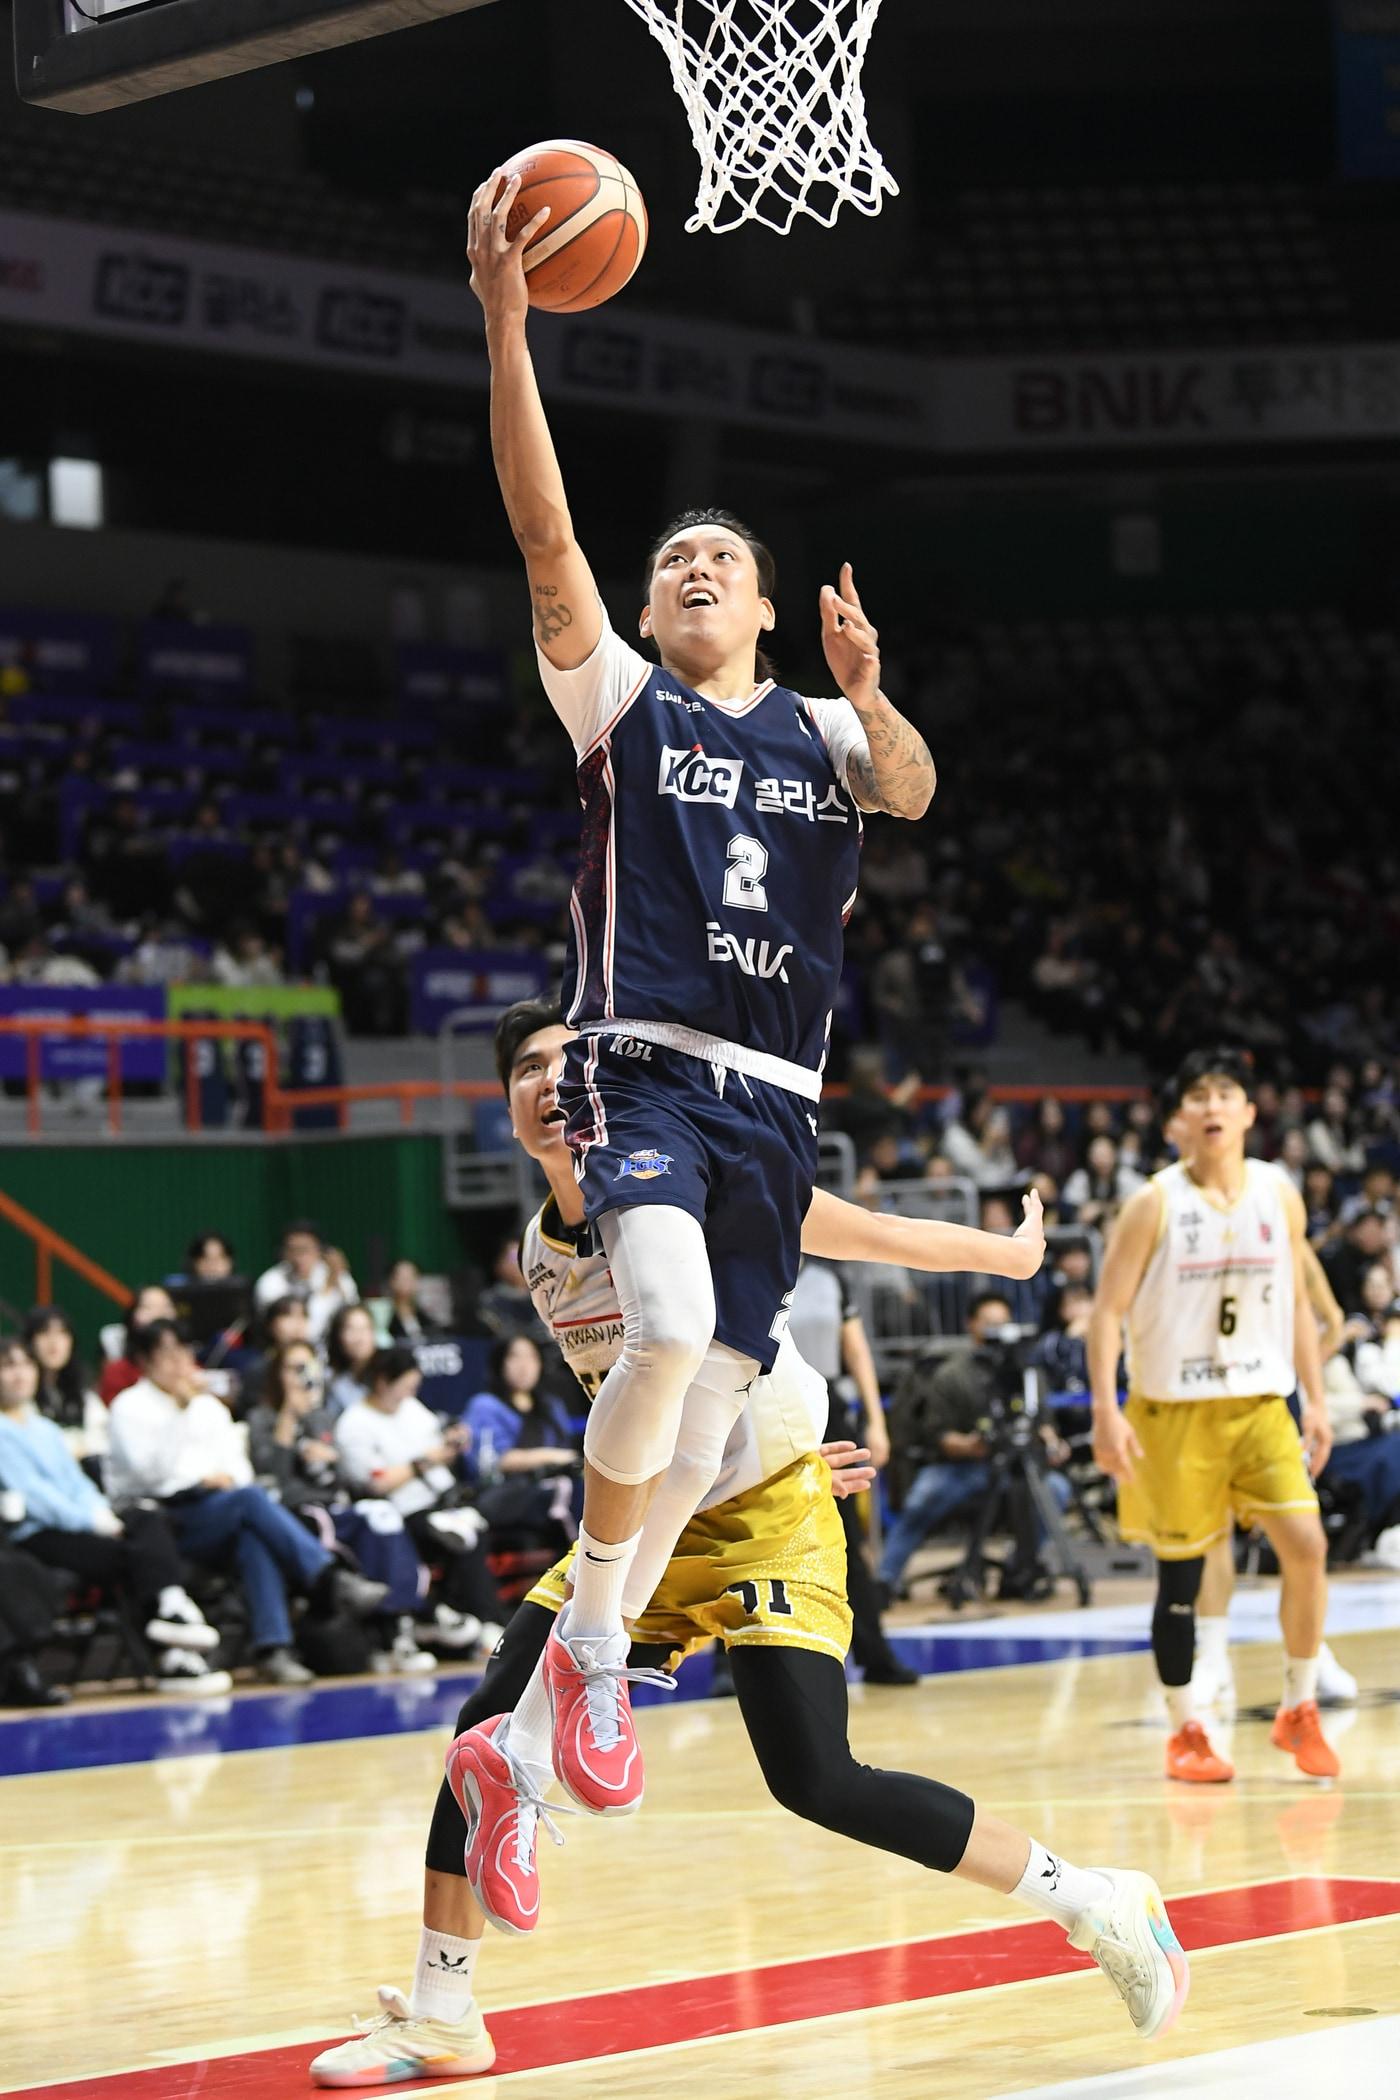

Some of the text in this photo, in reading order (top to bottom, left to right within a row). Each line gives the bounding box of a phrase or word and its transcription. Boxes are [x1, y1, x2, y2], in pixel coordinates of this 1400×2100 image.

[1013, 368, 1211, 431] BNK
[663, 748, 734, 800] KCC
[722, 833, 769, 913] 2
[706, 921, 794, 984] BNK
[609, 1035, 653, 1062] KBL
[1219, 1297, 1237, 1337] 6
